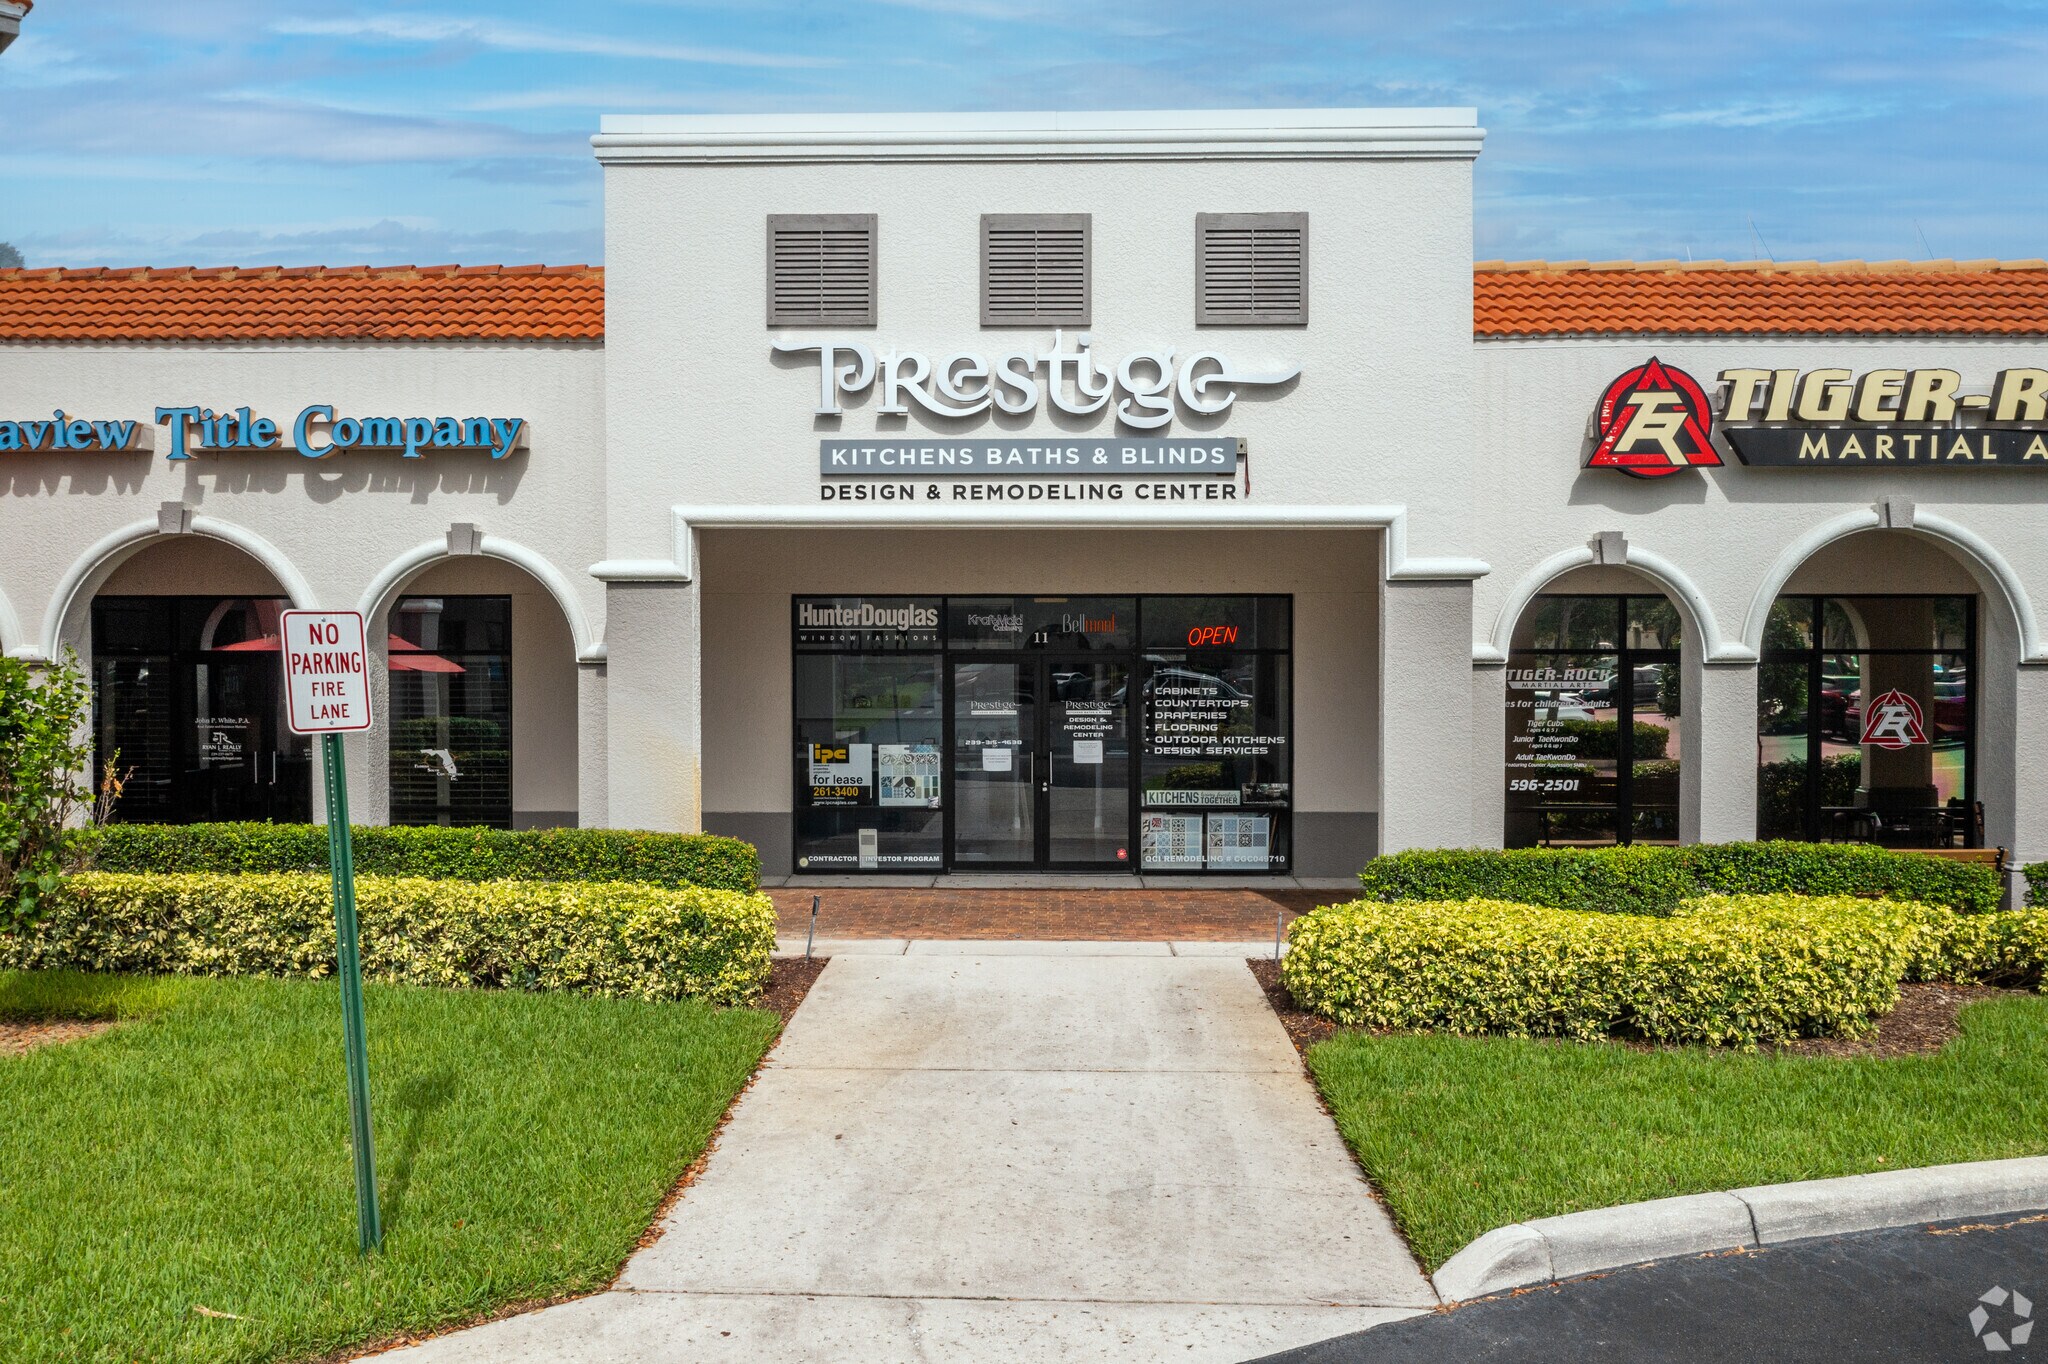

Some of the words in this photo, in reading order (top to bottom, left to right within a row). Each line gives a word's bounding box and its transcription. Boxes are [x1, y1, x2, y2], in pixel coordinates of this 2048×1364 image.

[771, 329, 1301, 429] Prestige
[0, 409, 136, 450] aview
[155, 405, 277, 460] Title
[294, 405, 523, 460] Company
[1799, 433, 1997, 460] MARTIAL
[831, 447, 974, 466] KITCHENS
[986, 447, 1080, 466] BATHS
[1093, 447, 1110, 466] &
[1121, 447, 1226, 466] BLINDS
[821, 484, 916, 500] DESIGN
[926, 484, 942, 500] &
[953, 484, 1127, 500] REMODELING
[1135, 484, 1237, 500] CENTER
[799, 602, 939, 631] HunterDouglas
[309, 623, 340, 645] NO
[1033, 631, 1049, 644] 11
[1187, 625, 1239, 646] OPEN
[291, 652, 362, 675] PARKING
[1507, 669, 1611, 681] TIGER-ROCK
[312, 681, 346, 697] FIRE
[1154, 687, 1218, 695] CABINETS
[966, 699, 1022, 711] Prestige
[1061, 699, 1117, 711] Prestige
[1154, 699, 1249, 708] COUNTERTOPS
[1517, 700, 1532, 708] for
[1535, 700, 1571, 708] children
[1581, 700, 1611, 708] adults
[311, 703, 350, 720] LANE
[1154, 711, 1227, 720] DRAPERIES
[1154, 723, 1218, 732] FLOORING
[1528, 720, 1545, 728] Tiger
[1154, 735, 1218, 744] OUTDOOR
[1222, 736, 1286, 744] KITCHENS
[1512, 735, 1535, 743] Junior
[1538, 735, 1579, 743] TaeKwonDo
[814, 743, 847, 765] ipc
[1154, 746, 1201, 755] DESIGN
[1205, 746, 1269, 755] SERVICES
[1514, 753, 1535, 761] Adult
[1535, 753, 1577, 761] TaeKwonDo
[813, 774, 830, 785] for
[833, 774, 864, 785] lease
[1509, 779, 1580, 791] 596-2501
[813, 786, 859, 797] 261-3400
[1149, 791, 1199, 804] KITCHENS
[1200, 796, 1238, 804] TOGETHER
